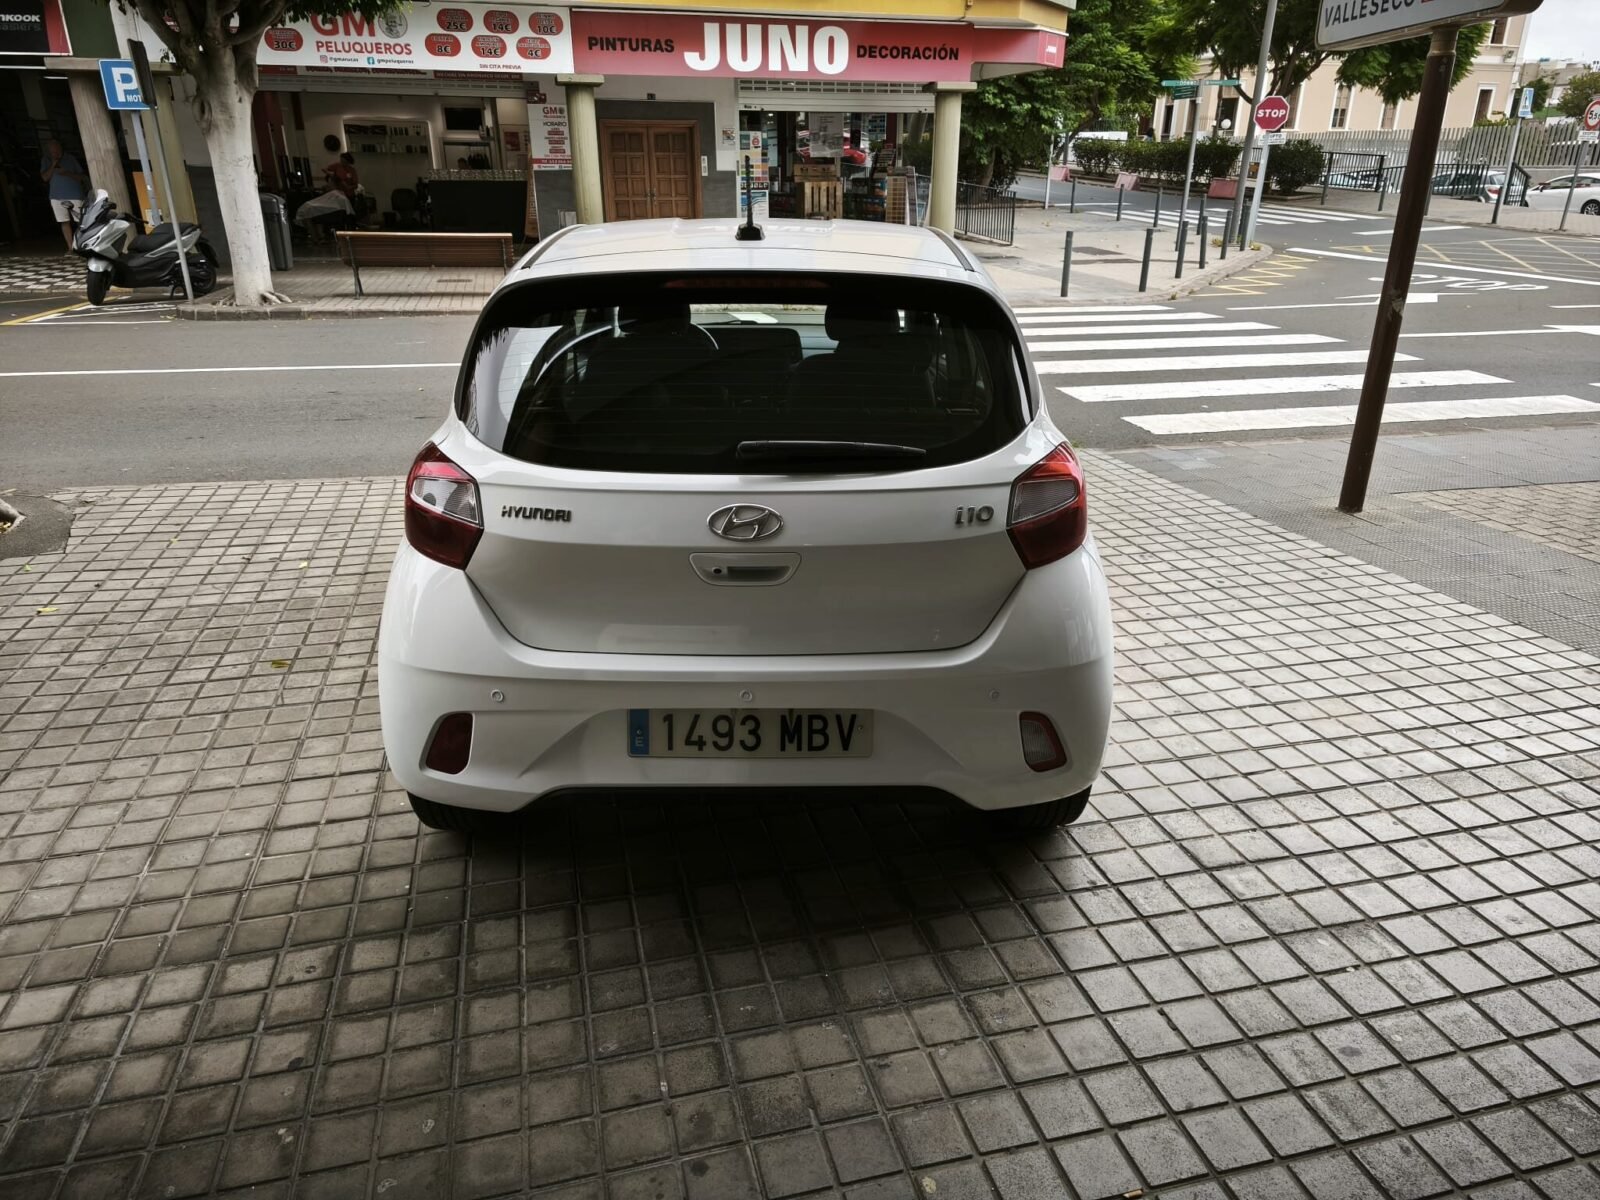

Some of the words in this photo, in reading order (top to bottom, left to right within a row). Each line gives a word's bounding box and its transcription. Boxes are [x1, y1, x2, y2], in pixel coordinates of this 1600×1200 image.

[310, 8, 376, 37] GM
[446, 21, 467, 31] 25€
[492, 22, 512, 32] 14€
[537, 24, 556, 34] 10€
[274, 39, 297, 50] 30€
[316, 41, 413, 56] PELUQUEROS
[437, 45, 451, 53] 8€
[588, 36, 675, 53] PINTURAS
[683, 22, 850, 75] JUNO
[856, 43, 960, 61] DECORACIÓN
[481, 47, 500, 57] 14€
[527, 49, 541, 58] 4€
[111, 67, 139, 102] P
[126, 94, 142, 103] MOT
[1257, 109, 1286, 118] STOP
[501, 505, 572, 523] HYUNDAI
[955, 506, 995, 525] i10
[662, 713, 762, 752] 1493
[779, 713, 857, 752] MBV
